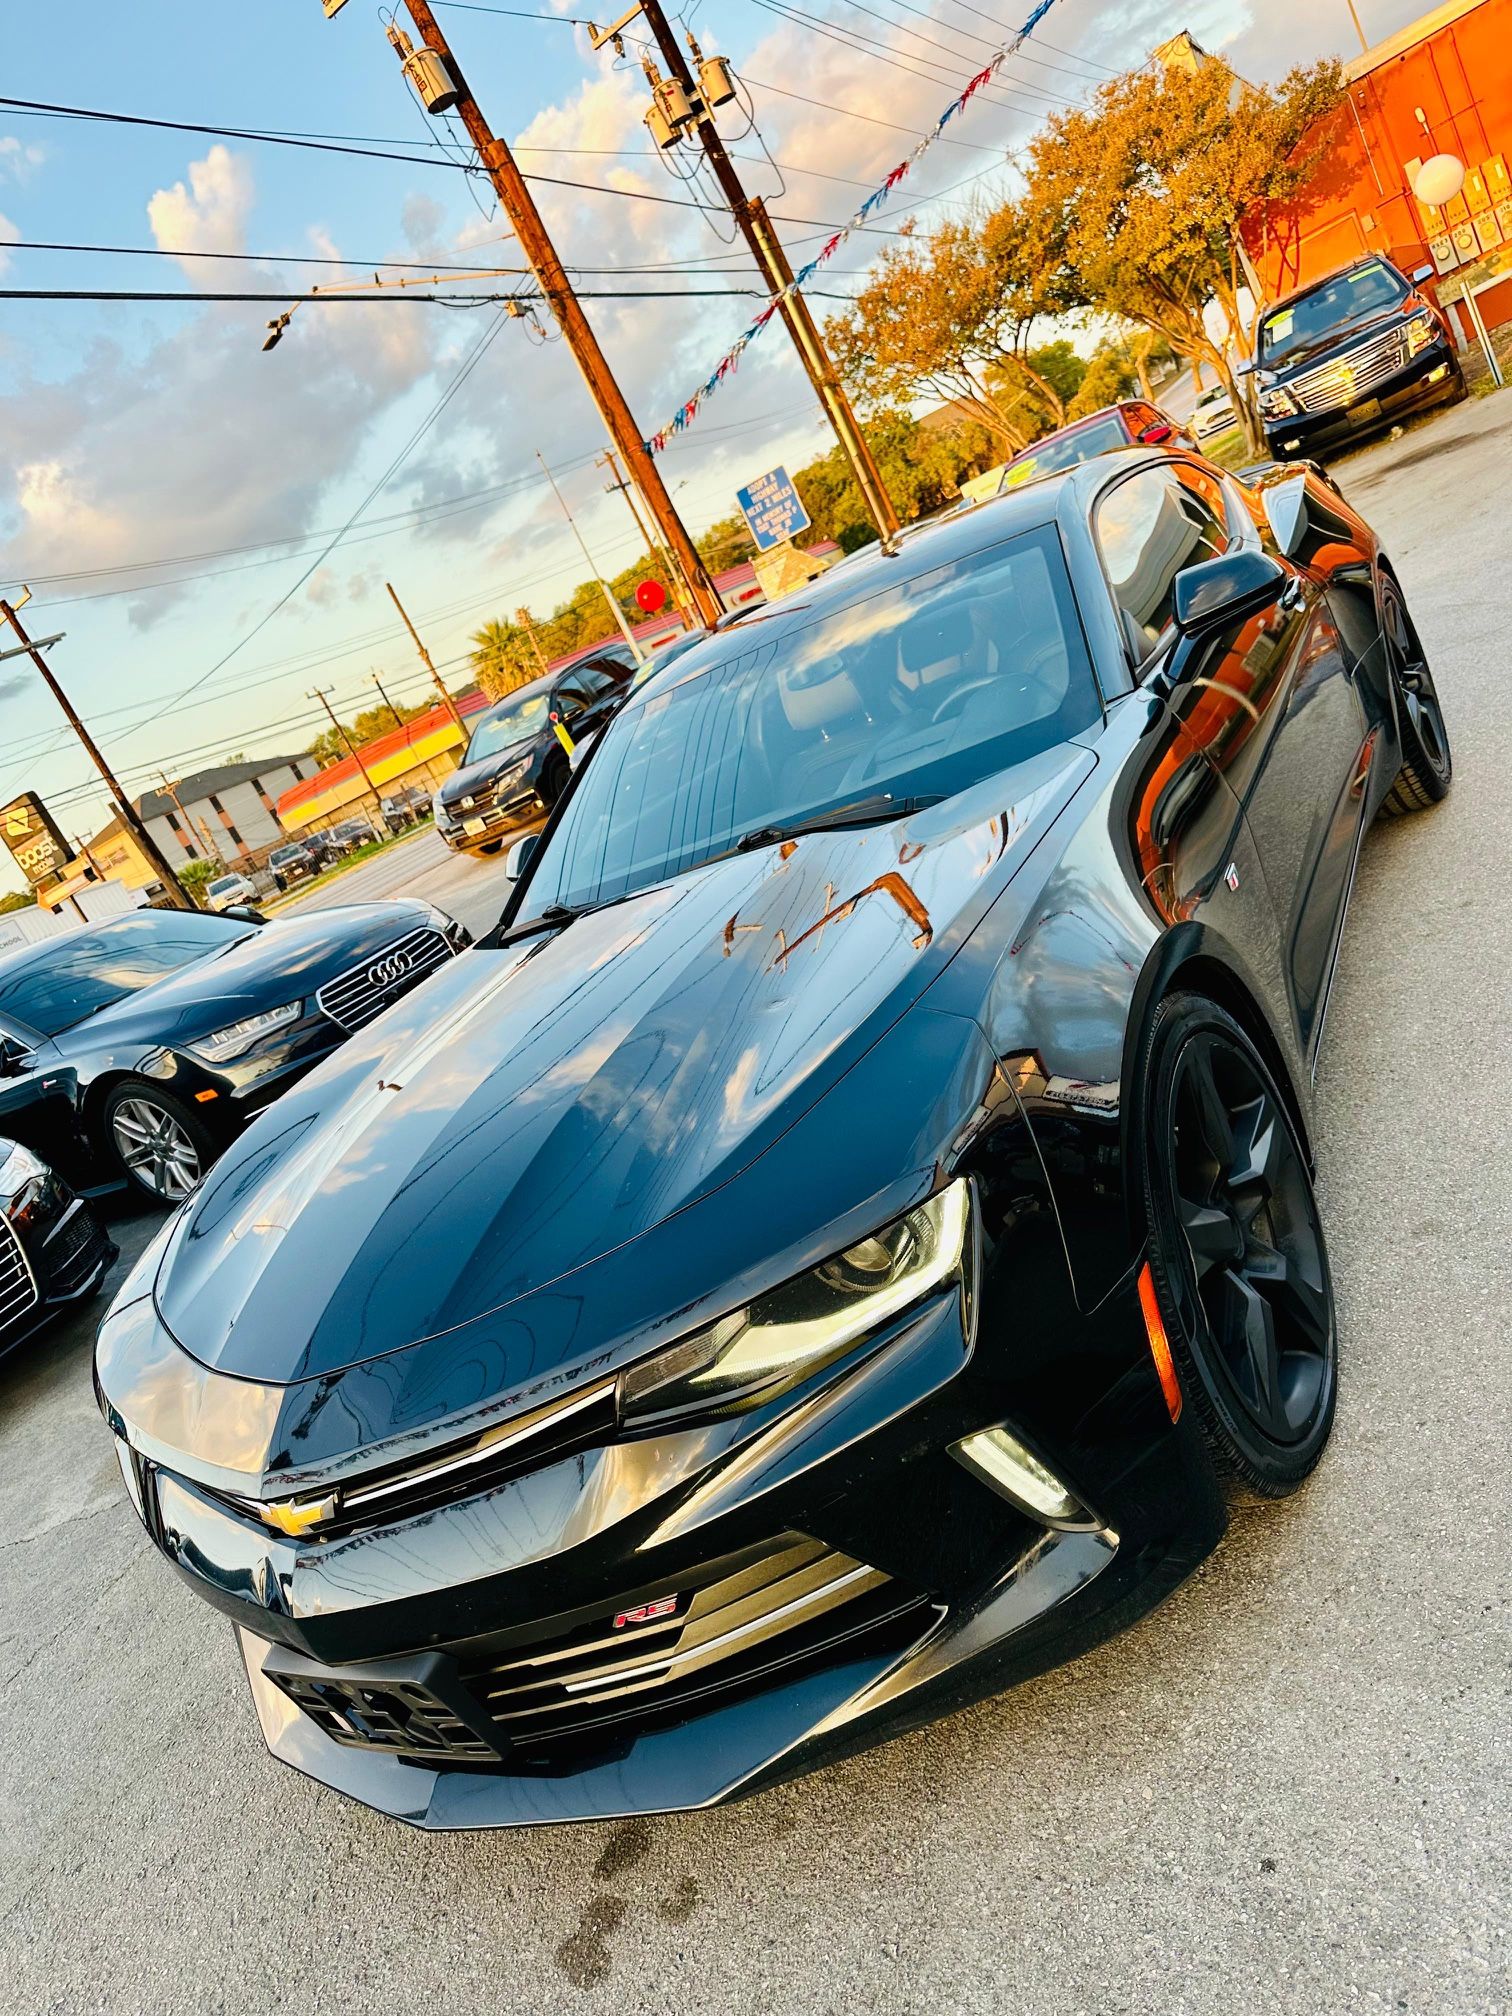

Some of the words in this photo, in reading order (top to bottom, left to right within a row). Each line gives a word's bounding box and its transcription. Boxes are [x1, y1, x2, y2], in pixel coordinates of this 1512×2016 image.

[747, 477, 768, 495] ADOPT
[751, 481, 779, 504] HIGHWAY
[746, 502, 763, 518] NEXT
[764, 497, 772, 507] 2
[771, 485, 793, 503] MILES
[13, 834, 59, 870] boost
[32, 856, 55, 875] mobile
[613, 1593, 678, 1628] RS
